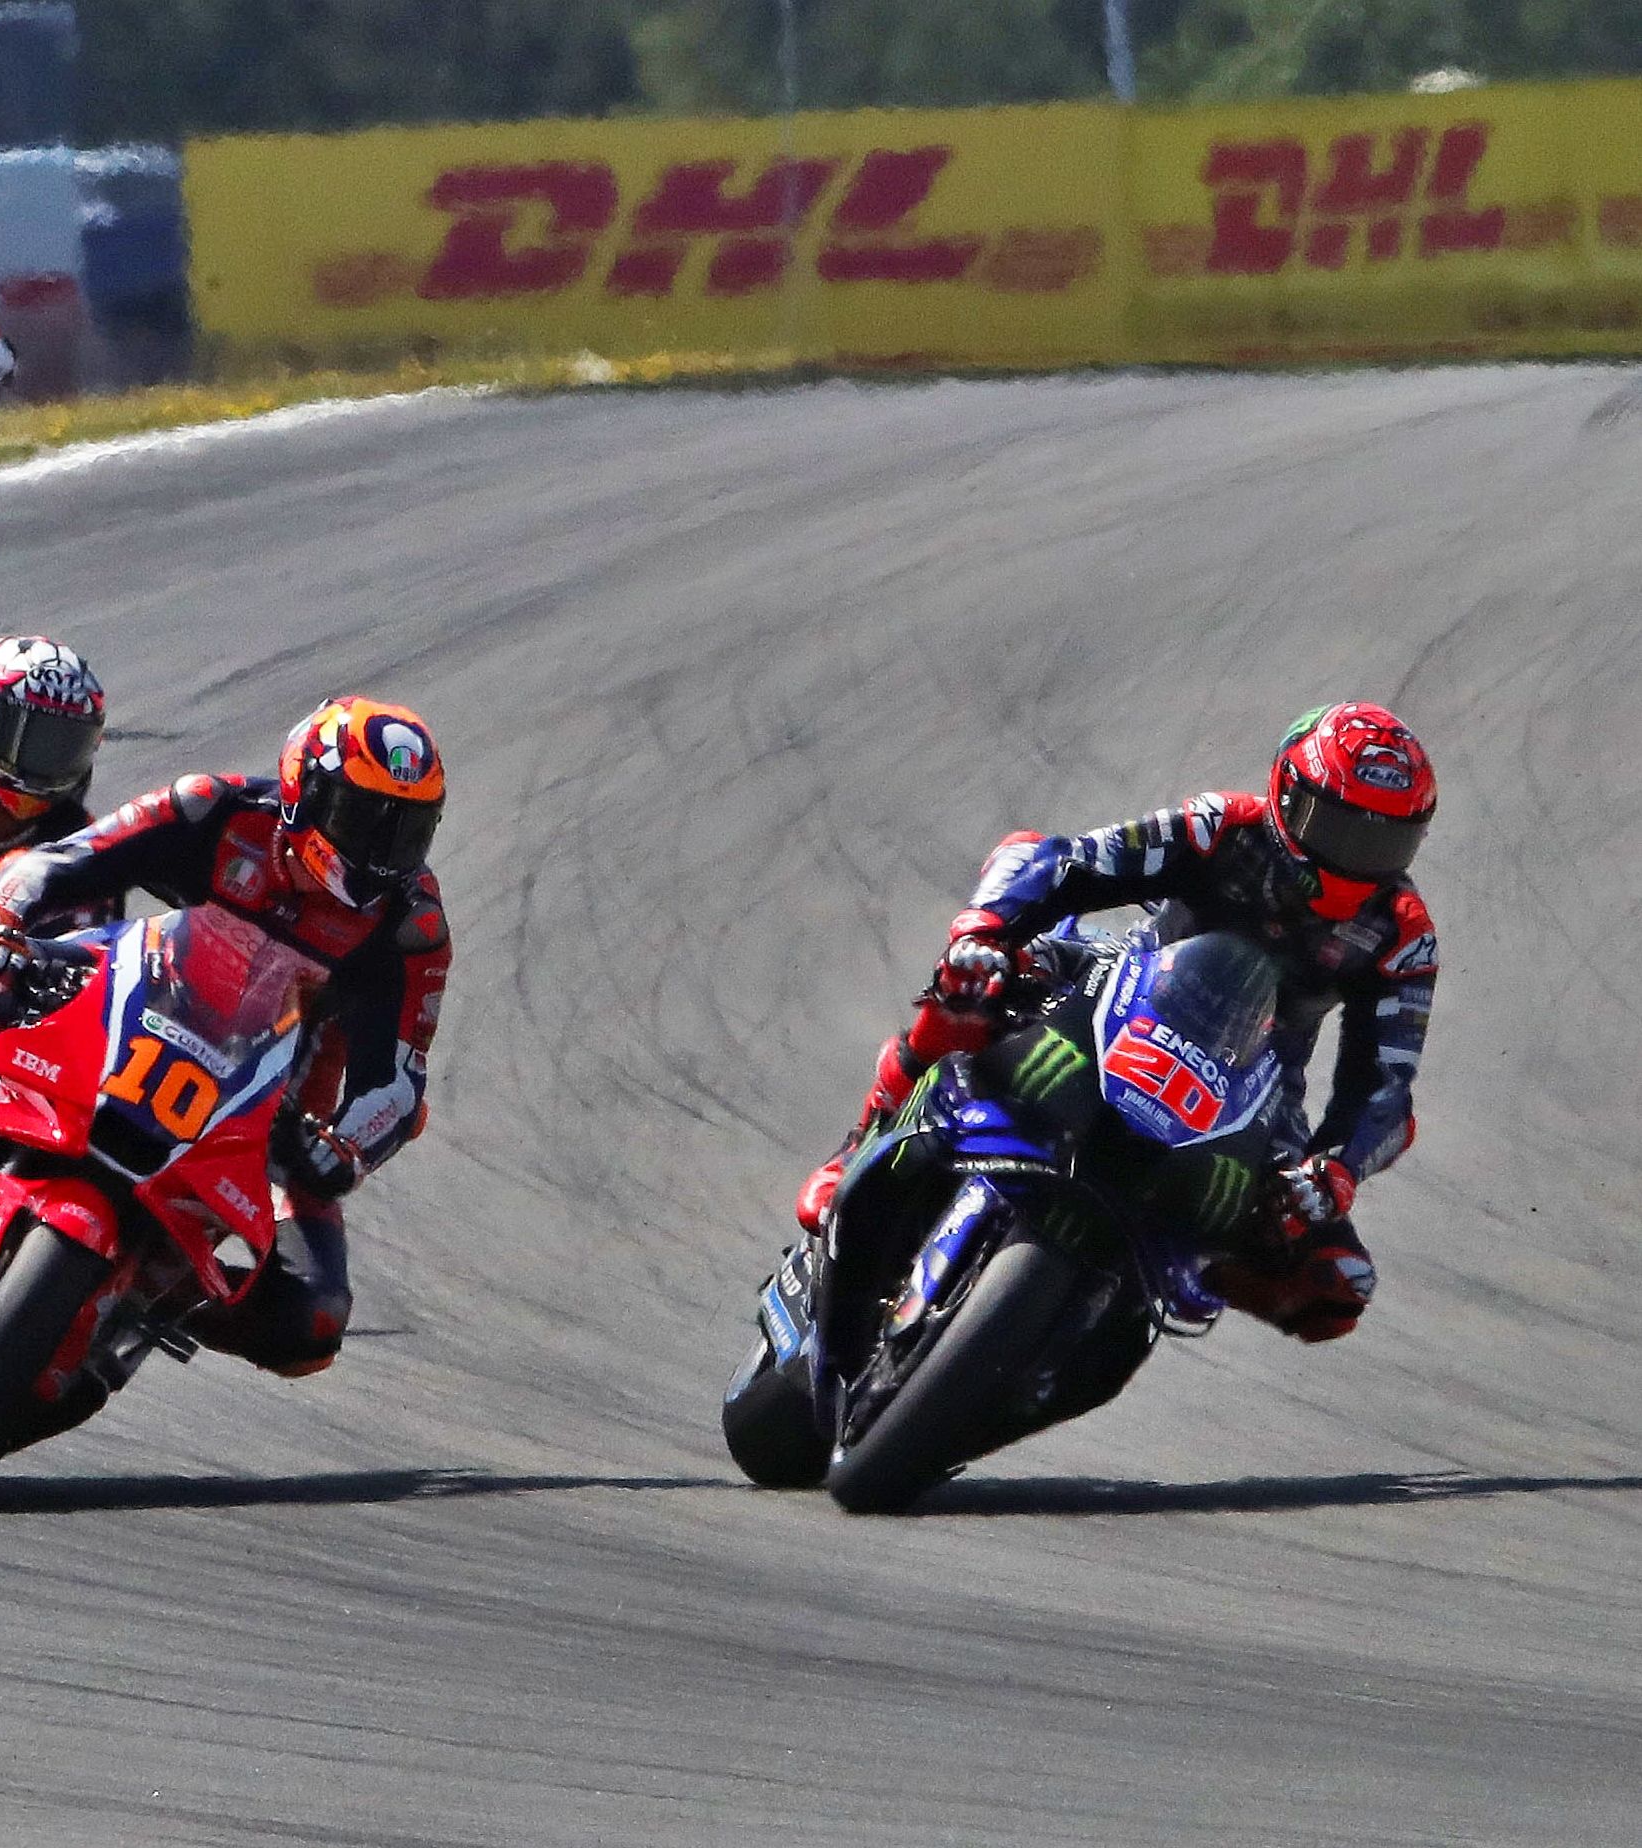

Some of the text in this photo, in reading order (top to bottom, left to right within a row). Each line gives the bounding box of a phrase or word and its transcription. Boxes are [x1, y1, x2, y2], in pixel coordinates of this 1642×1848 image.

[414, 144, 980, 299] DHL
[1204, 120, 1506, 273] DHL
[11, 1047, 62, 1083] IBM
[100, 1036, 219, 1141] 10
[1103, 1023, 1225, 1133] 20
[1150, 1023, 1231, 1101] ENEOS
[215, 1176, 261, 1221] IBM
